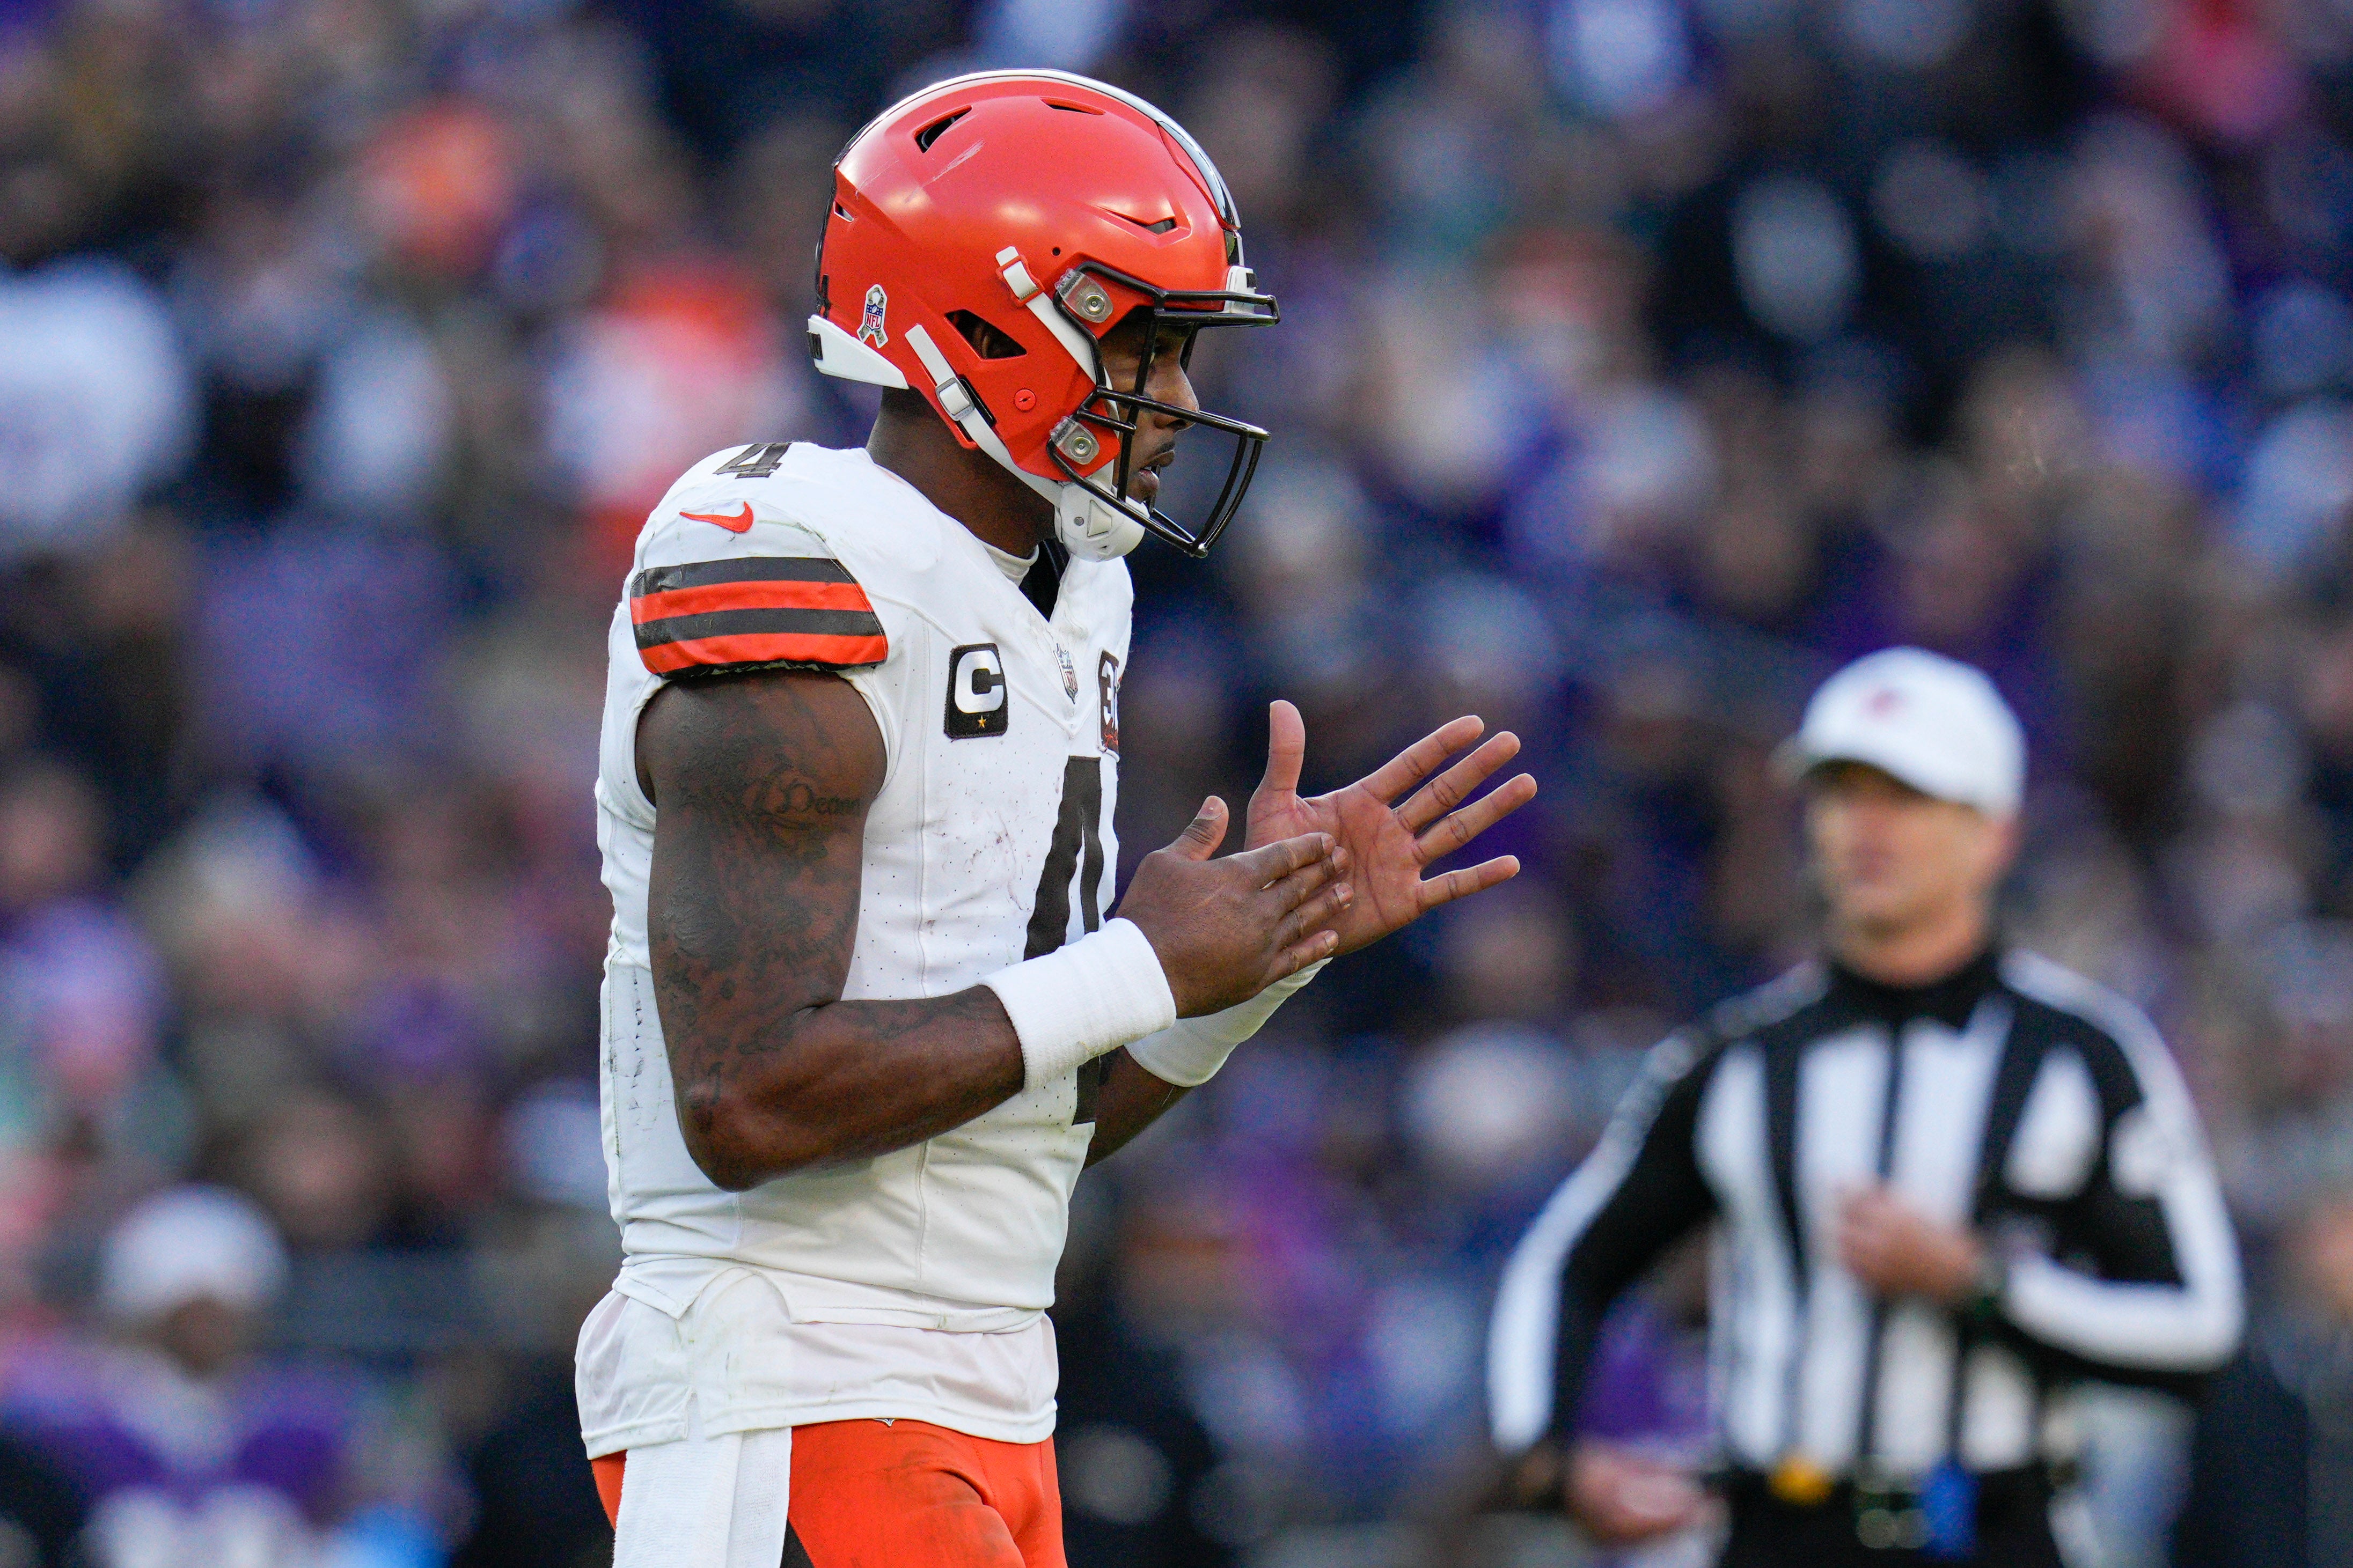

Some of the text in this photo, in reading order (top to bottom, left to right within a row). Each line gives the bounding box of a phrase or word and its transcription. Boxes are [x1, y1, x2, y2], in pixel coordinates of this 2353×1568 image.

[866, 313, 880, 328] NFL
[713, 443, 791, 479] 4
[955, 650, 1005, 713] C
[1102, 660, 1118, 730] 3
